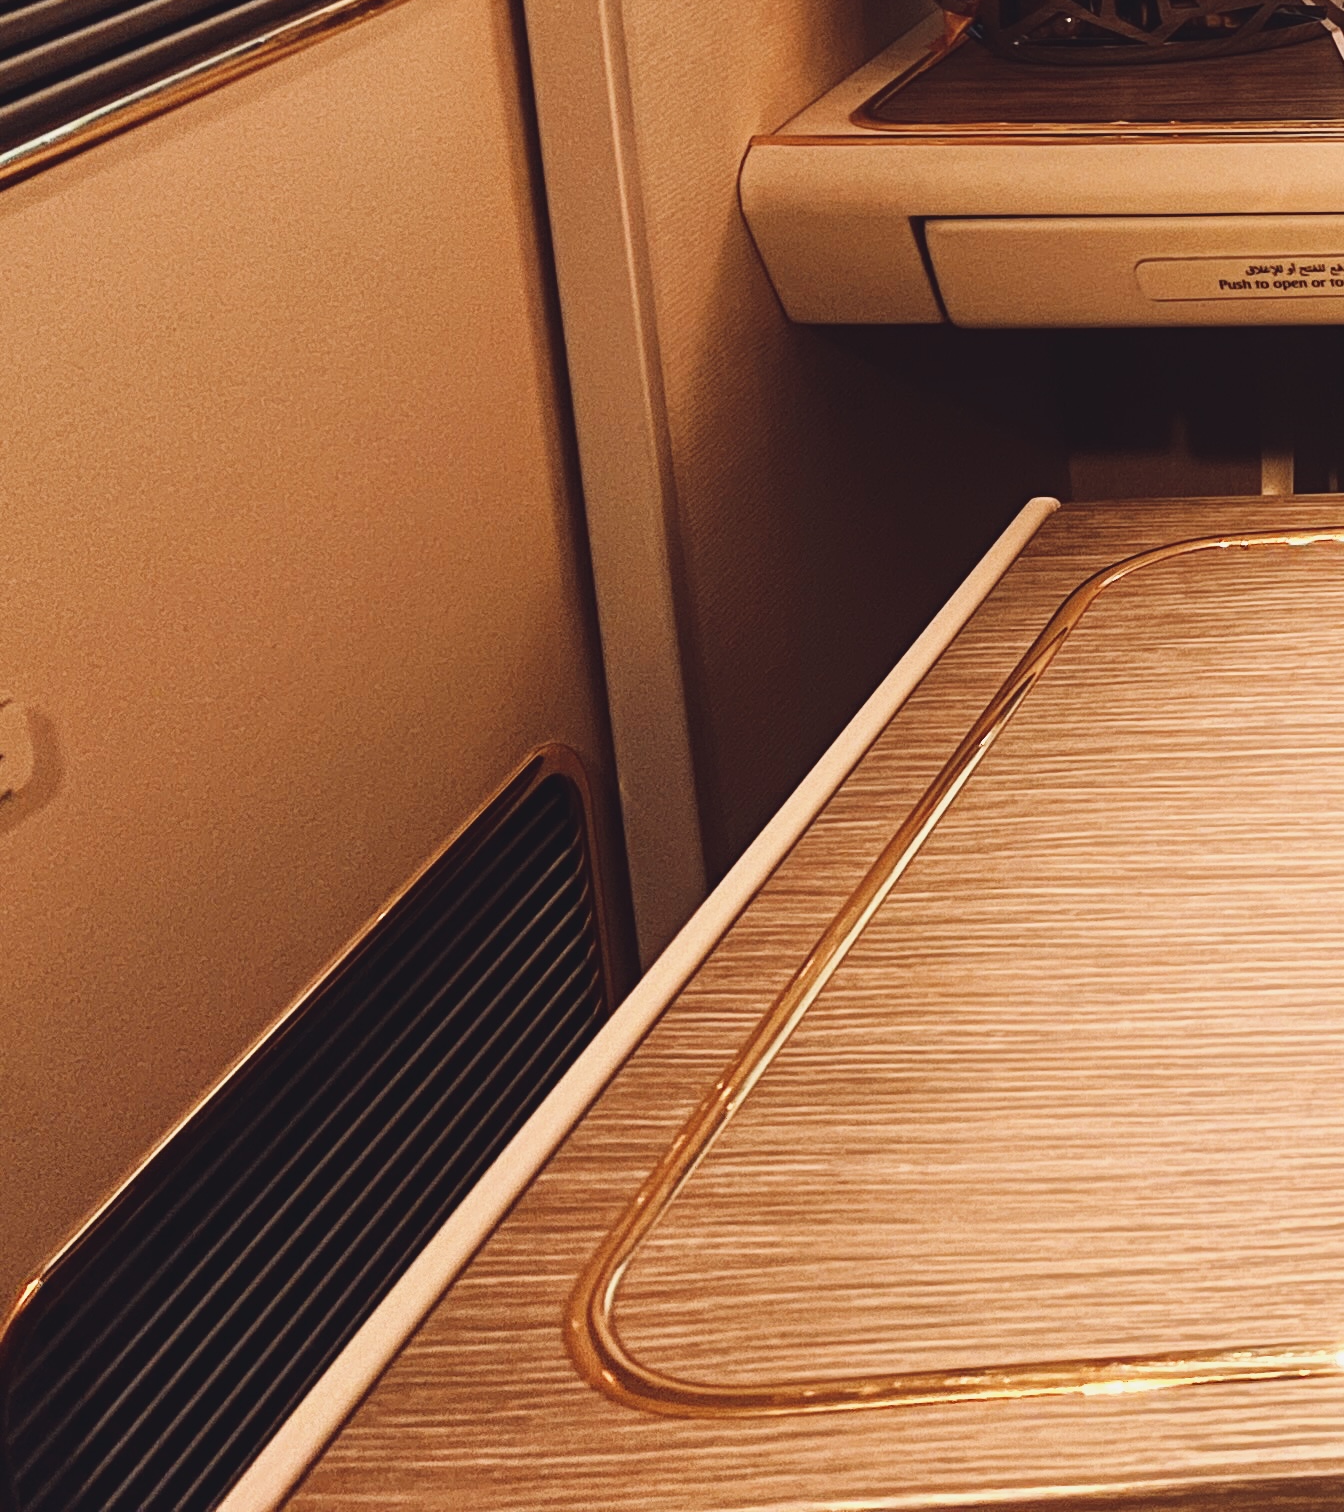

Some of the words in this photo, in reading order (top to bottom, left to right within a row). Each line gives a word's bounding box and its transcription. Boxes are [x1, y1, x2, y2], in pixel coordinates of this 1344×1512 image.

[1219, 279, 1250, 290] Push
[1255, 279, 1269, 288] to
[1273, 279, 1307, 291] open
[1311, 278, 1326, 288] or
[1330, 278, 1344, 287] to
